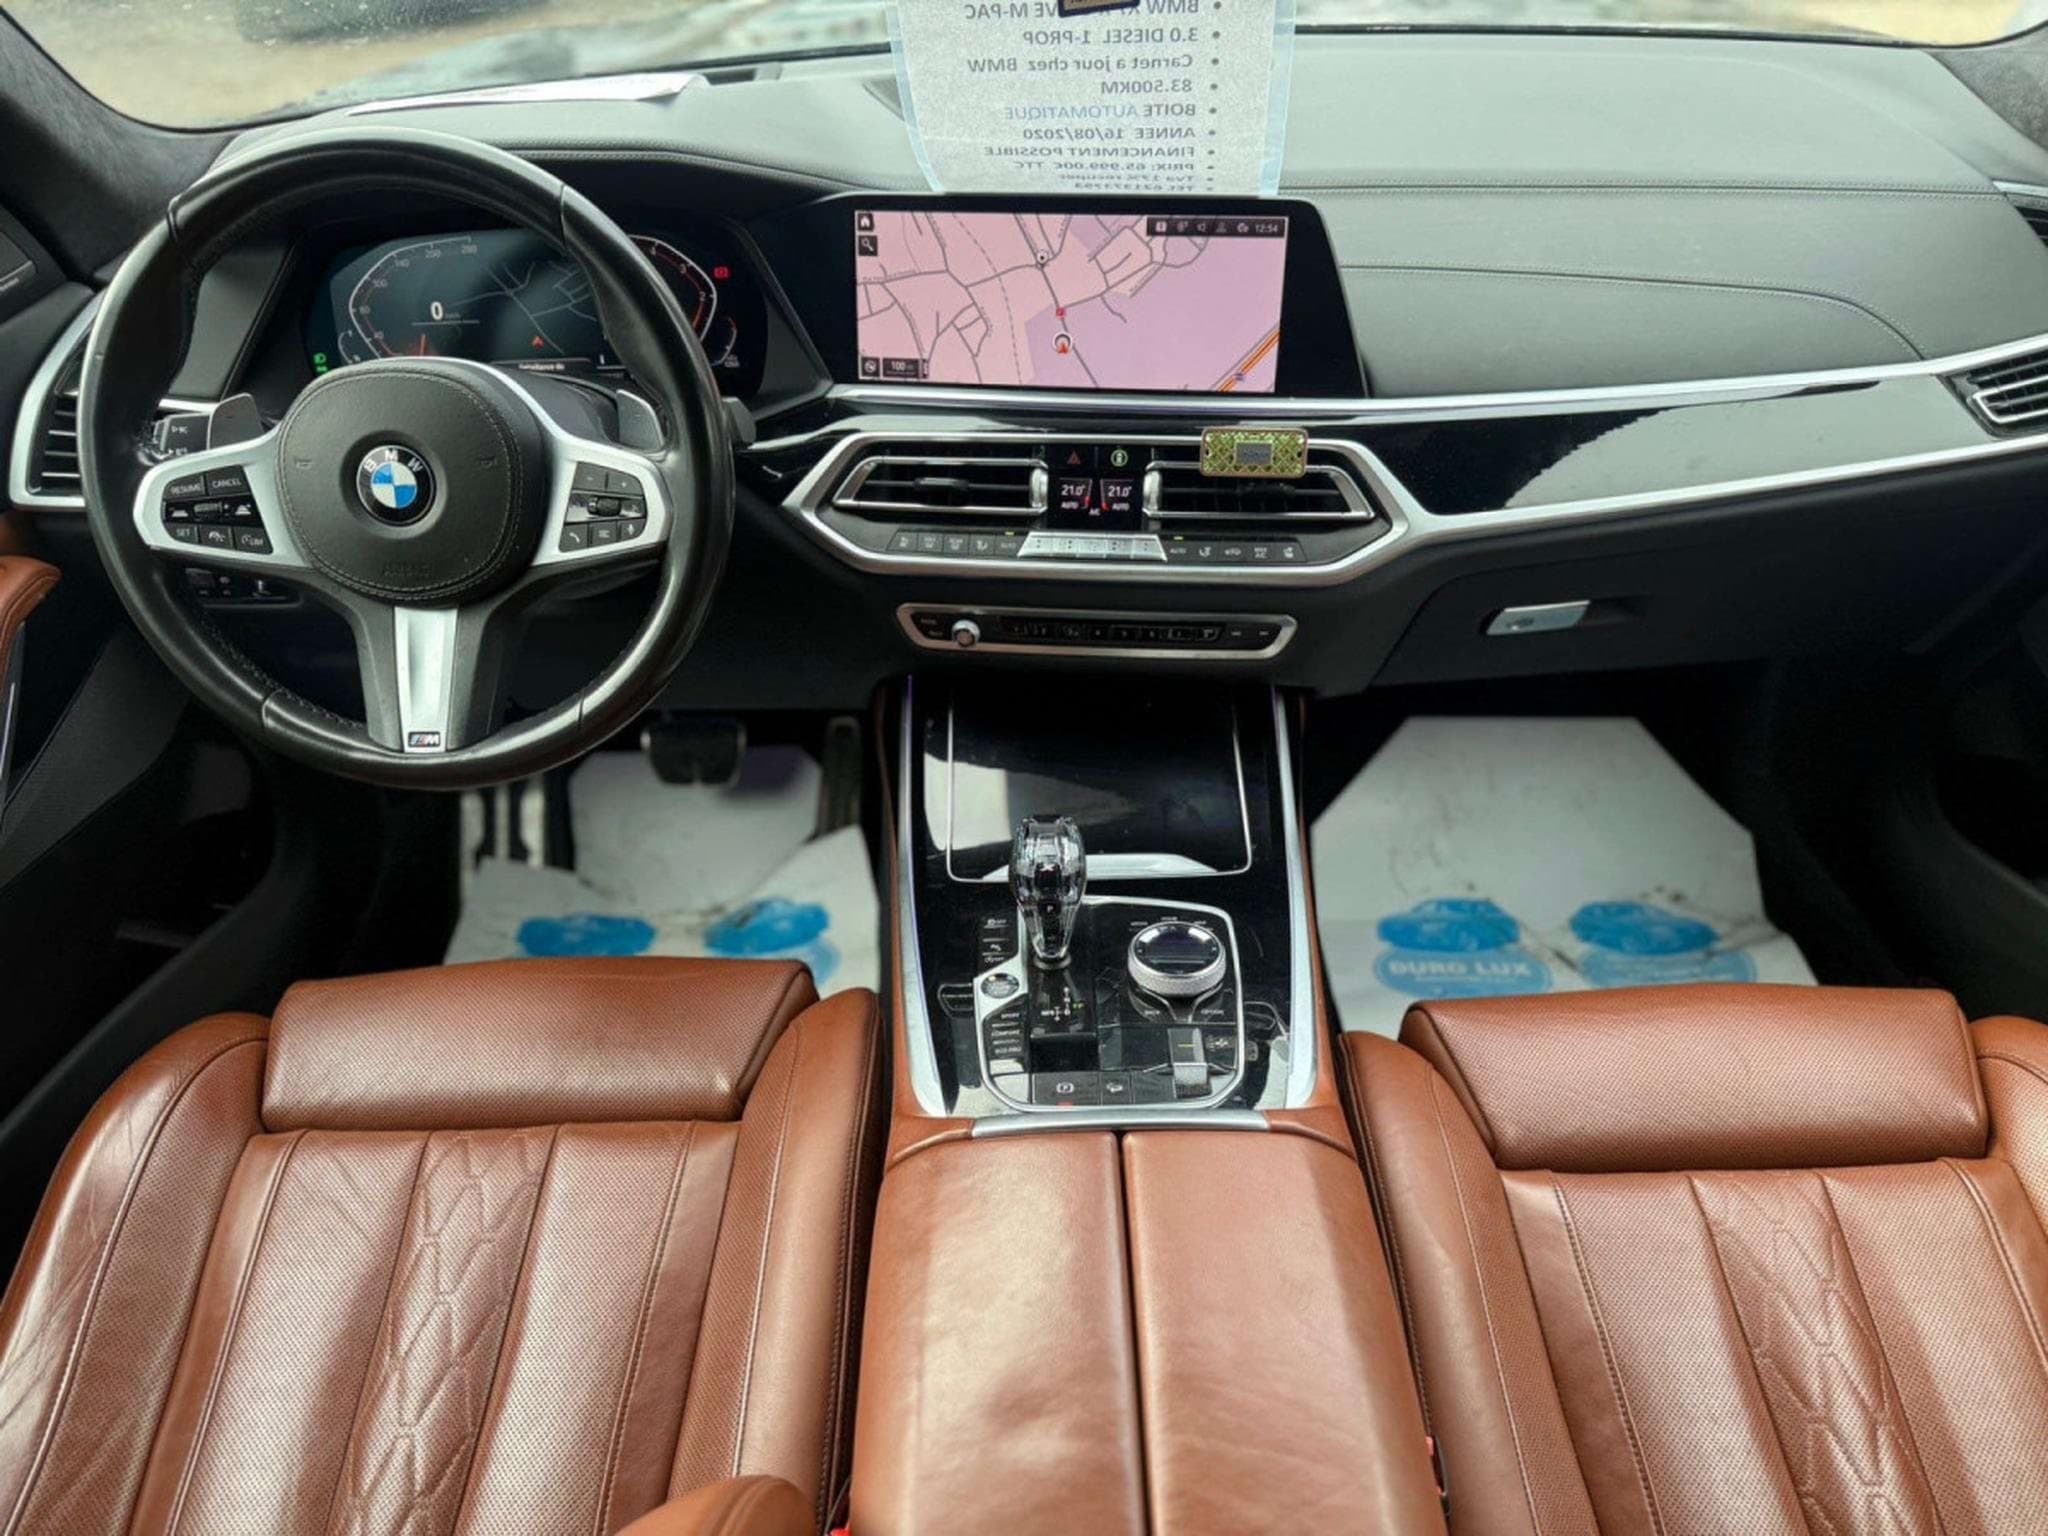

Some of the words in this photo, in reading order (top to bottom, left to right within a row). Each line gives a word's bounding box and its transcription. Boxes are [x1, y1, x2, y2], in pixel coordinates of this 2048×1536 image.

[1254, 222, 1280, 234] 12:54
[430, 301, 444, 321] 0
[363, 449, 424, 473] BMW
[212, 478, 242, 489] CANCEL
[1061, 501, 1079, 509] AUTO
[176, 528, 190, 536] SET
